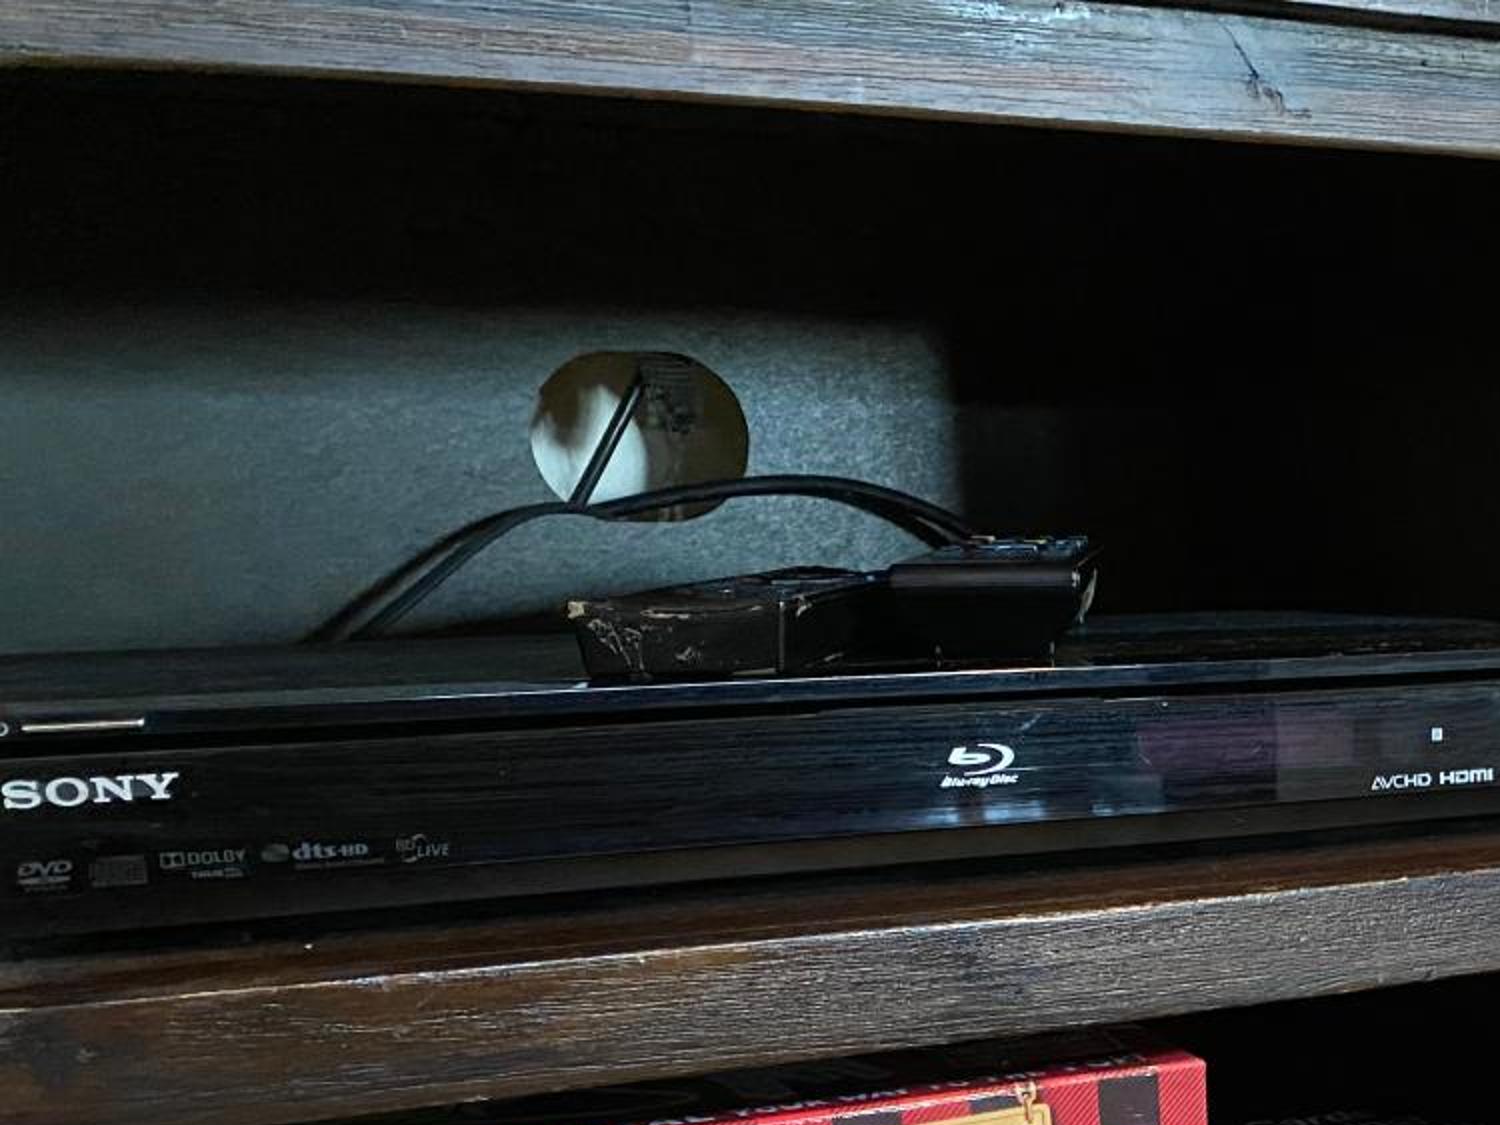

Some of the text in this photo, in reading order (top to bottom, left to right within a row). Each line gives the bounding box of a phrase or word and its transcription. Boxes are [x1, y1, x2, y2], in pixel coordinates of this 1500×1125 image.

[1371, 773, 1431, 790] AVCHD
[1439, 767, 1494, 785] HDMI
[1, 772, 180, 809] SONY
[187, 848, 246, 866] DOLBY
